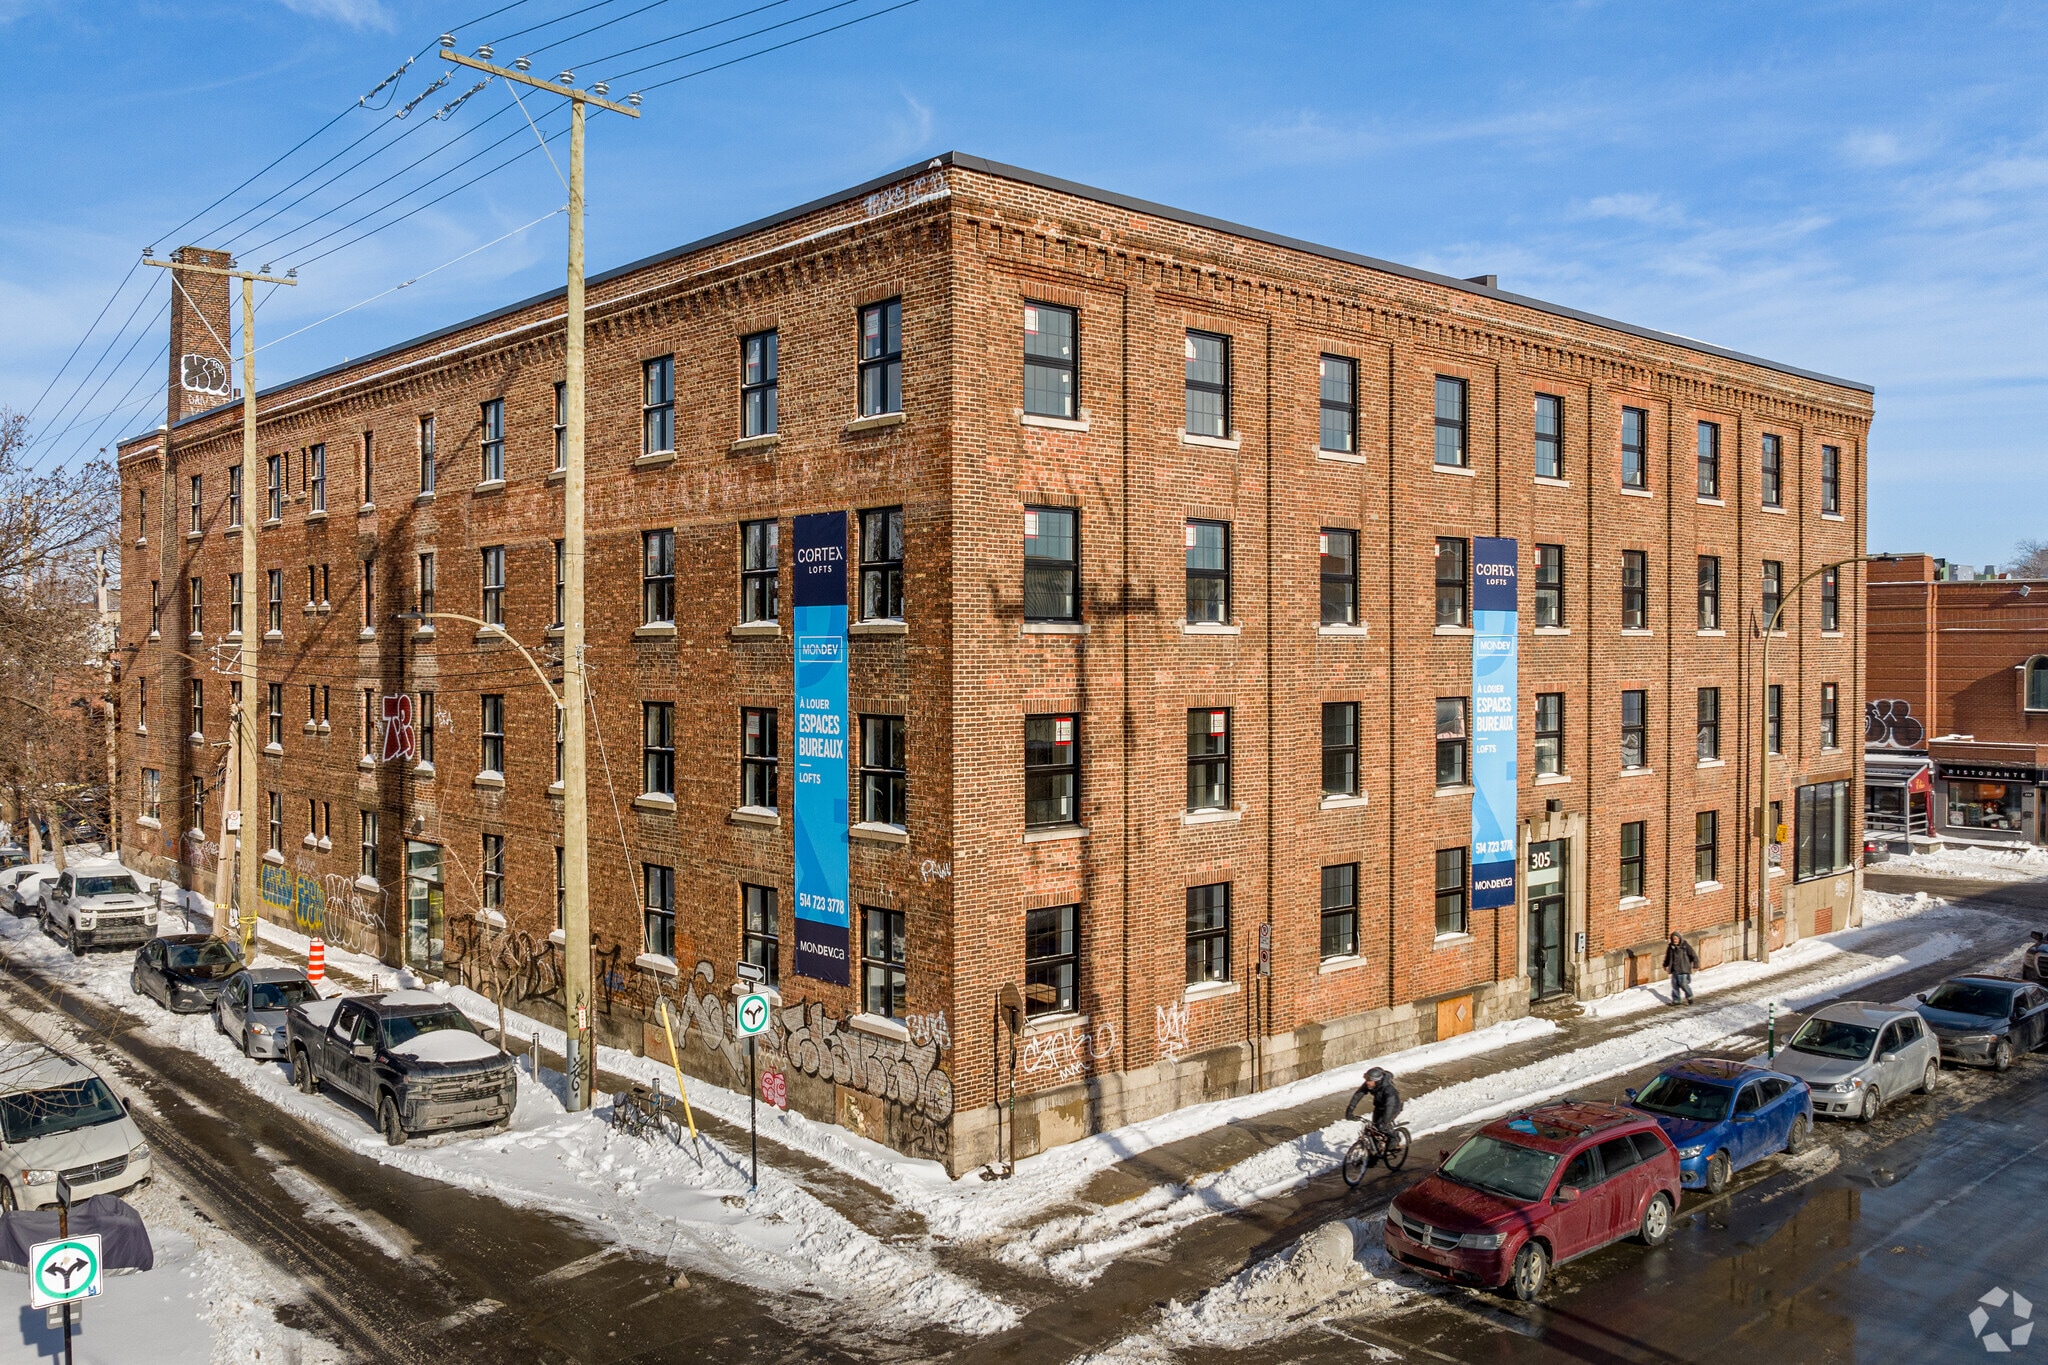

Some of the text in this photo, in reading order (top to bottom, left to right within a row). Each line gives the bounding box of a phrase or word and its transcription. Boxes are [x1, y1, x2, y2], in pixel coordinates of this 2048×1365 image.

[797, 546, 843, 563] CORTEX
[808, 565, 832, 574] LOFTS
[1476, 563, 1515, 576] CORTEX
[1486, 578, 1507, 586] LOFTS
[802, 643, 839, 655] MONDEV
[1480, 640, 1511, 651] MONDEV
[1483, 684, 1504, 693] LOUER
[799, 696, 830, 710] À LOUER
[1476, 697, 1512, 713] ESPACES
[799, 713, 840, 735] ESPACES
[1476, 715, 1514, 732] BUREAUX
[799, 736, 843, 759] BUREAUX
[1476, 744, 1497, 754] LOFTS
[799, 772, 821, 785] LOFTS
[1948, 769, 2026, 779] RISTORANTE
[1475, 843, 1486, 854] 514
[1487, 841, 1500, 853] 723
[1531, 851, 1551, 870] 305
[799, 893, 845, 915] 514 723 3778
[800, 940, 845, 960] MONDEV.ca
